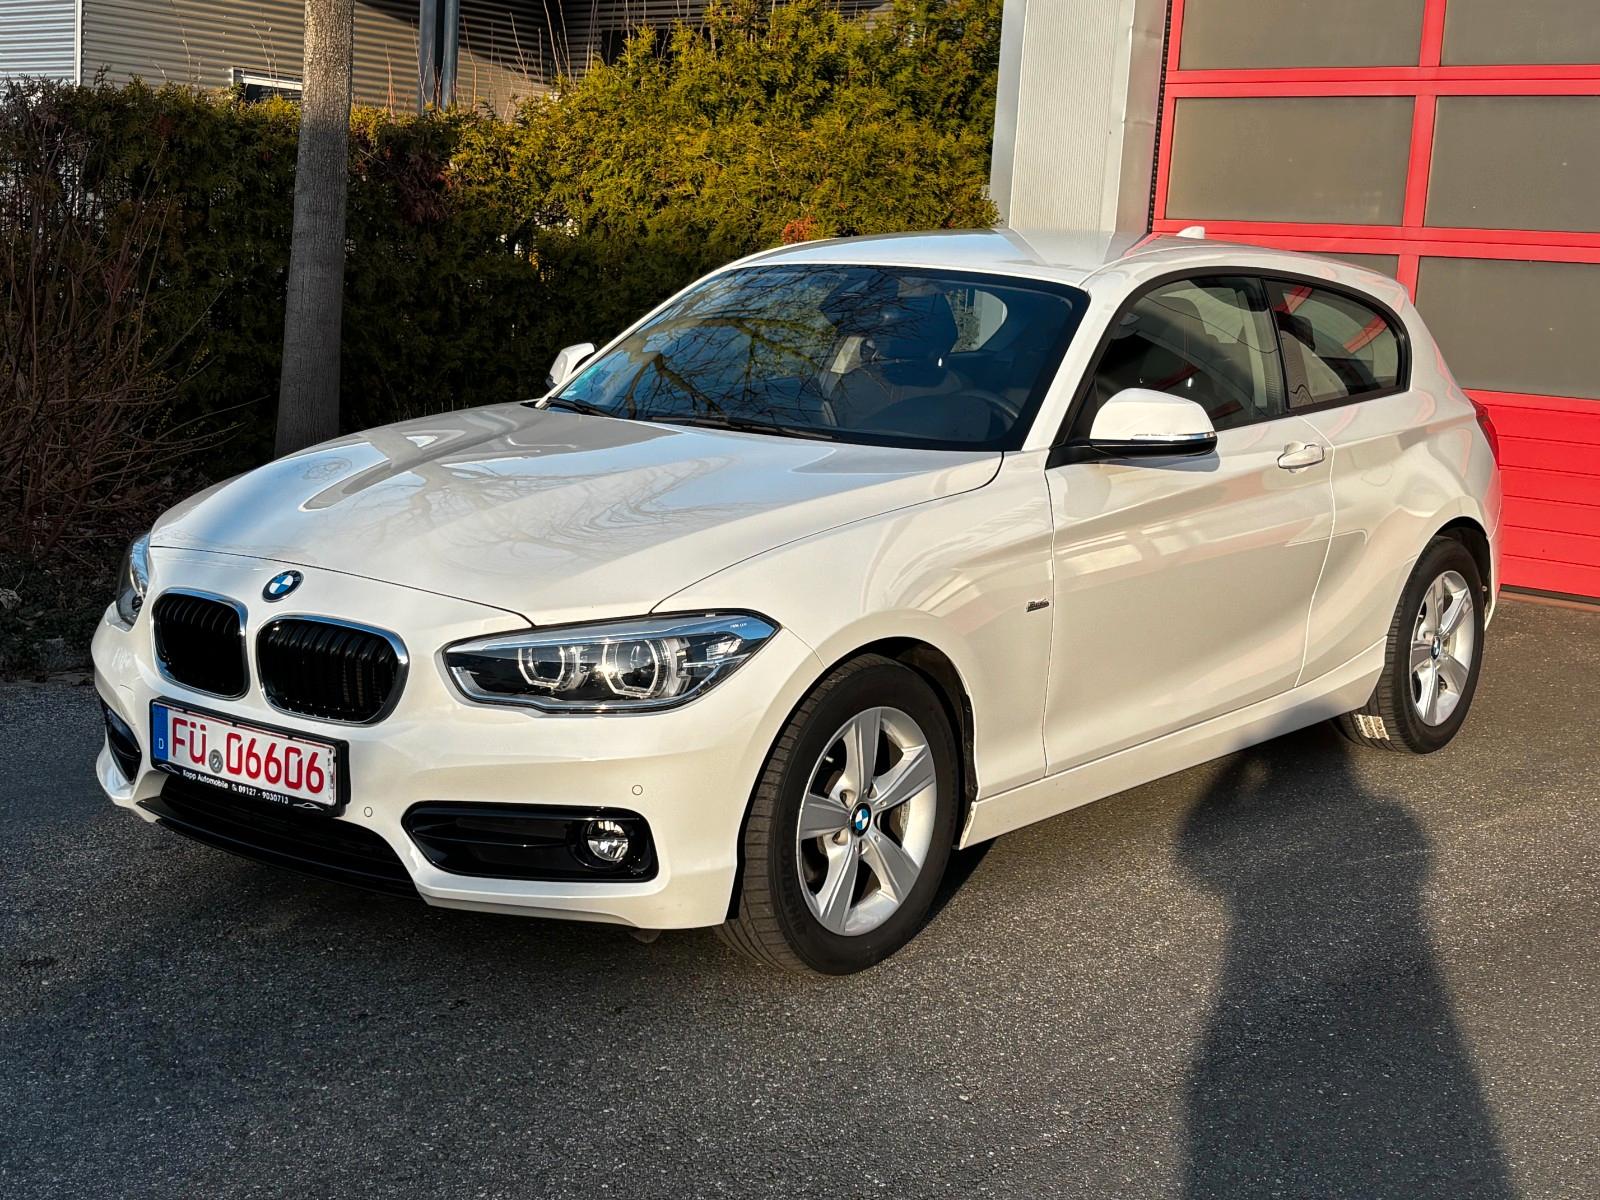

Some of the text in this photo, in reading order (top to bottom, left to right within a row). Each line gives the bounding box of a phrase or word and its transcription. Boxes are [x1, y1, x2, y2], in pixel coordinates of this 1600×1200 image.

[158, 738, 164, 750] D
[172, 717, 206, 766] FÜ
[226, 732, 325, 794] 06606
